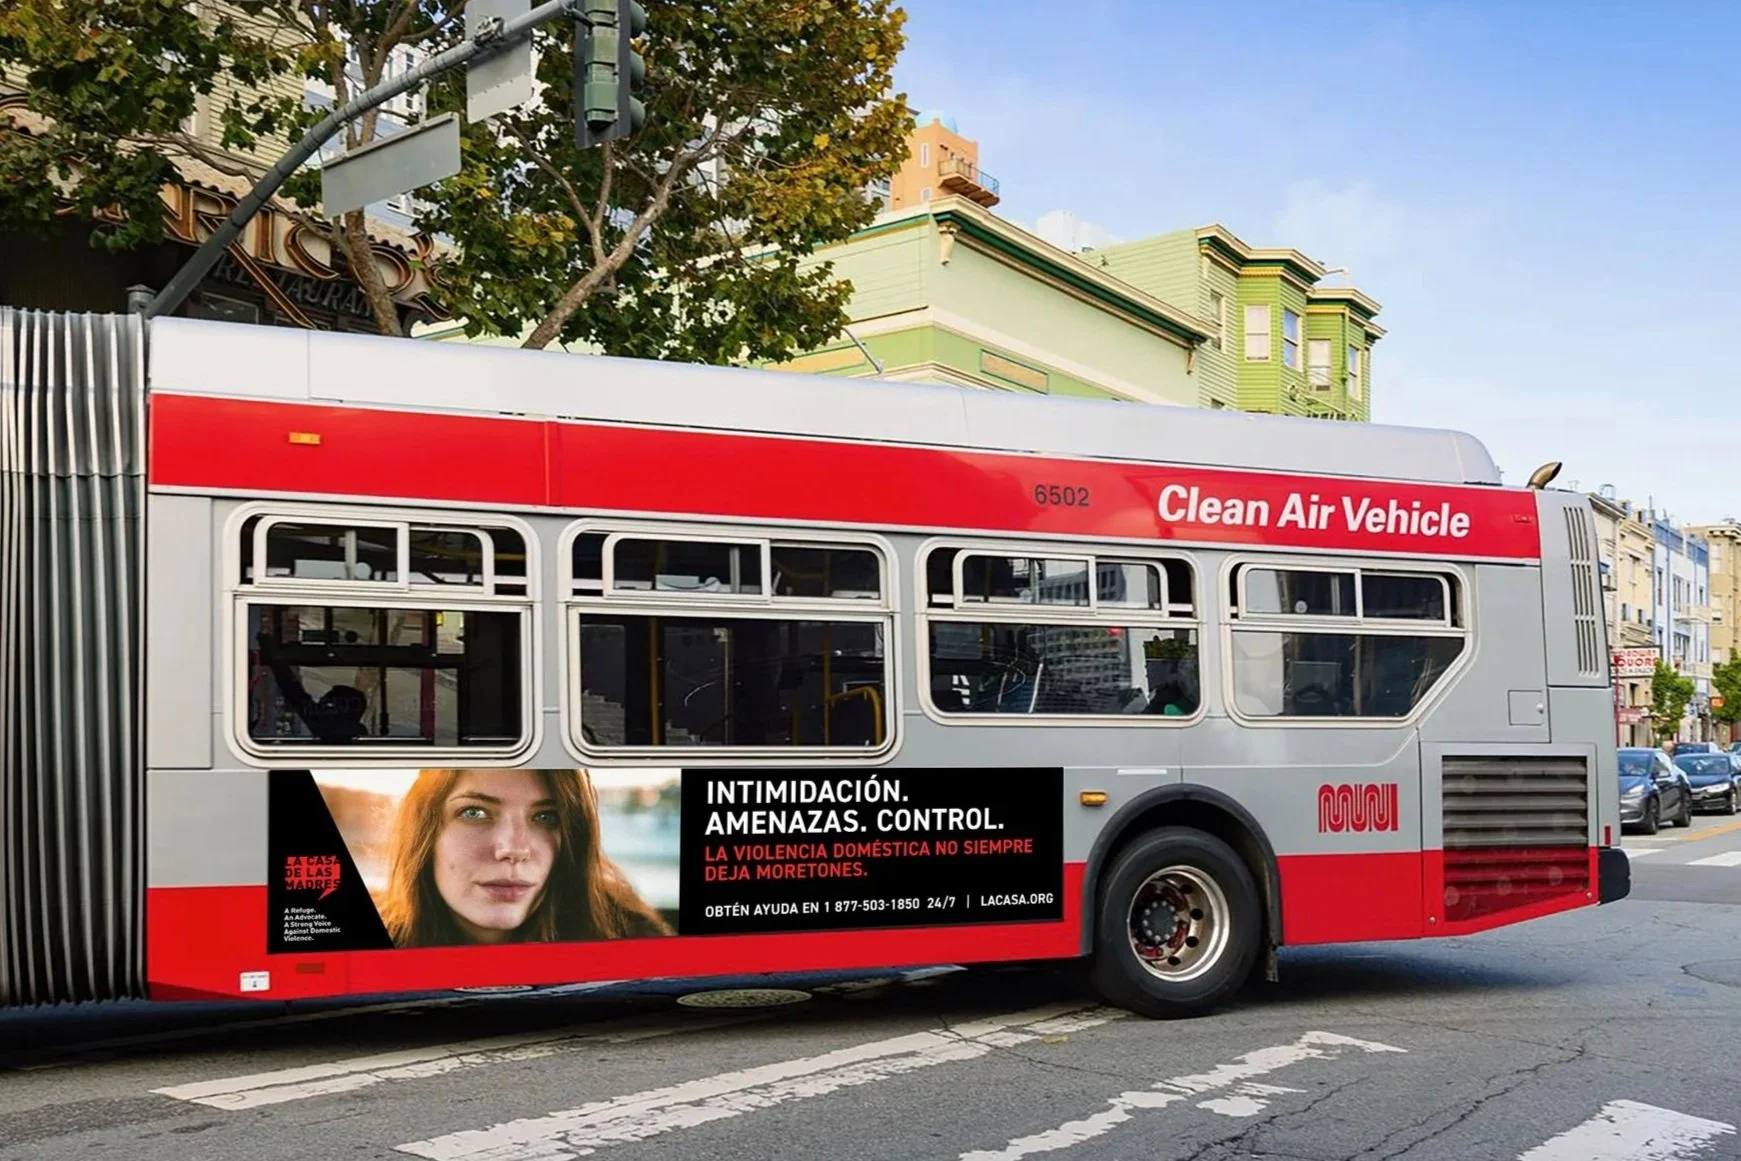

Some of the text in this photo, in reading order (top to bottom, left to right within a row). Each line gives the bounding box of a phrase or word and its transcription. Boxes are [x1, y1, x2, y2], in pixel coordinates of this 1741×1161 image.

[1034, 484, 1090, 507] 6502
[1158, 484, 1470, 537] Clean Air Vehicle
[706, 774, 909, 805] INTIMIDACIÓN.
[704, 807, 1004, 836] AMENAZAS. CONTROL.
[705, 838, 1033, 862] LA VIOLENCIA DOMÉSTICA NO SIEMPRE
[285, 867, 333, 878] DE LAS
[705, 862, 868, 882] DEJA MORETONES.
[285, 879, 340, 890] MADRES
[704, 901, 750, 918] OBTÉN
[753, 902, 799, 916] AYUDA
[802, 901, 820, 914] EN
[824, 901, 830, 913] 1
[834, 897, 920, 913] 877-503-1850
[927, 895, 956, 910] 24/7
[980, 892, 1054, 908] LACASA.ORG
